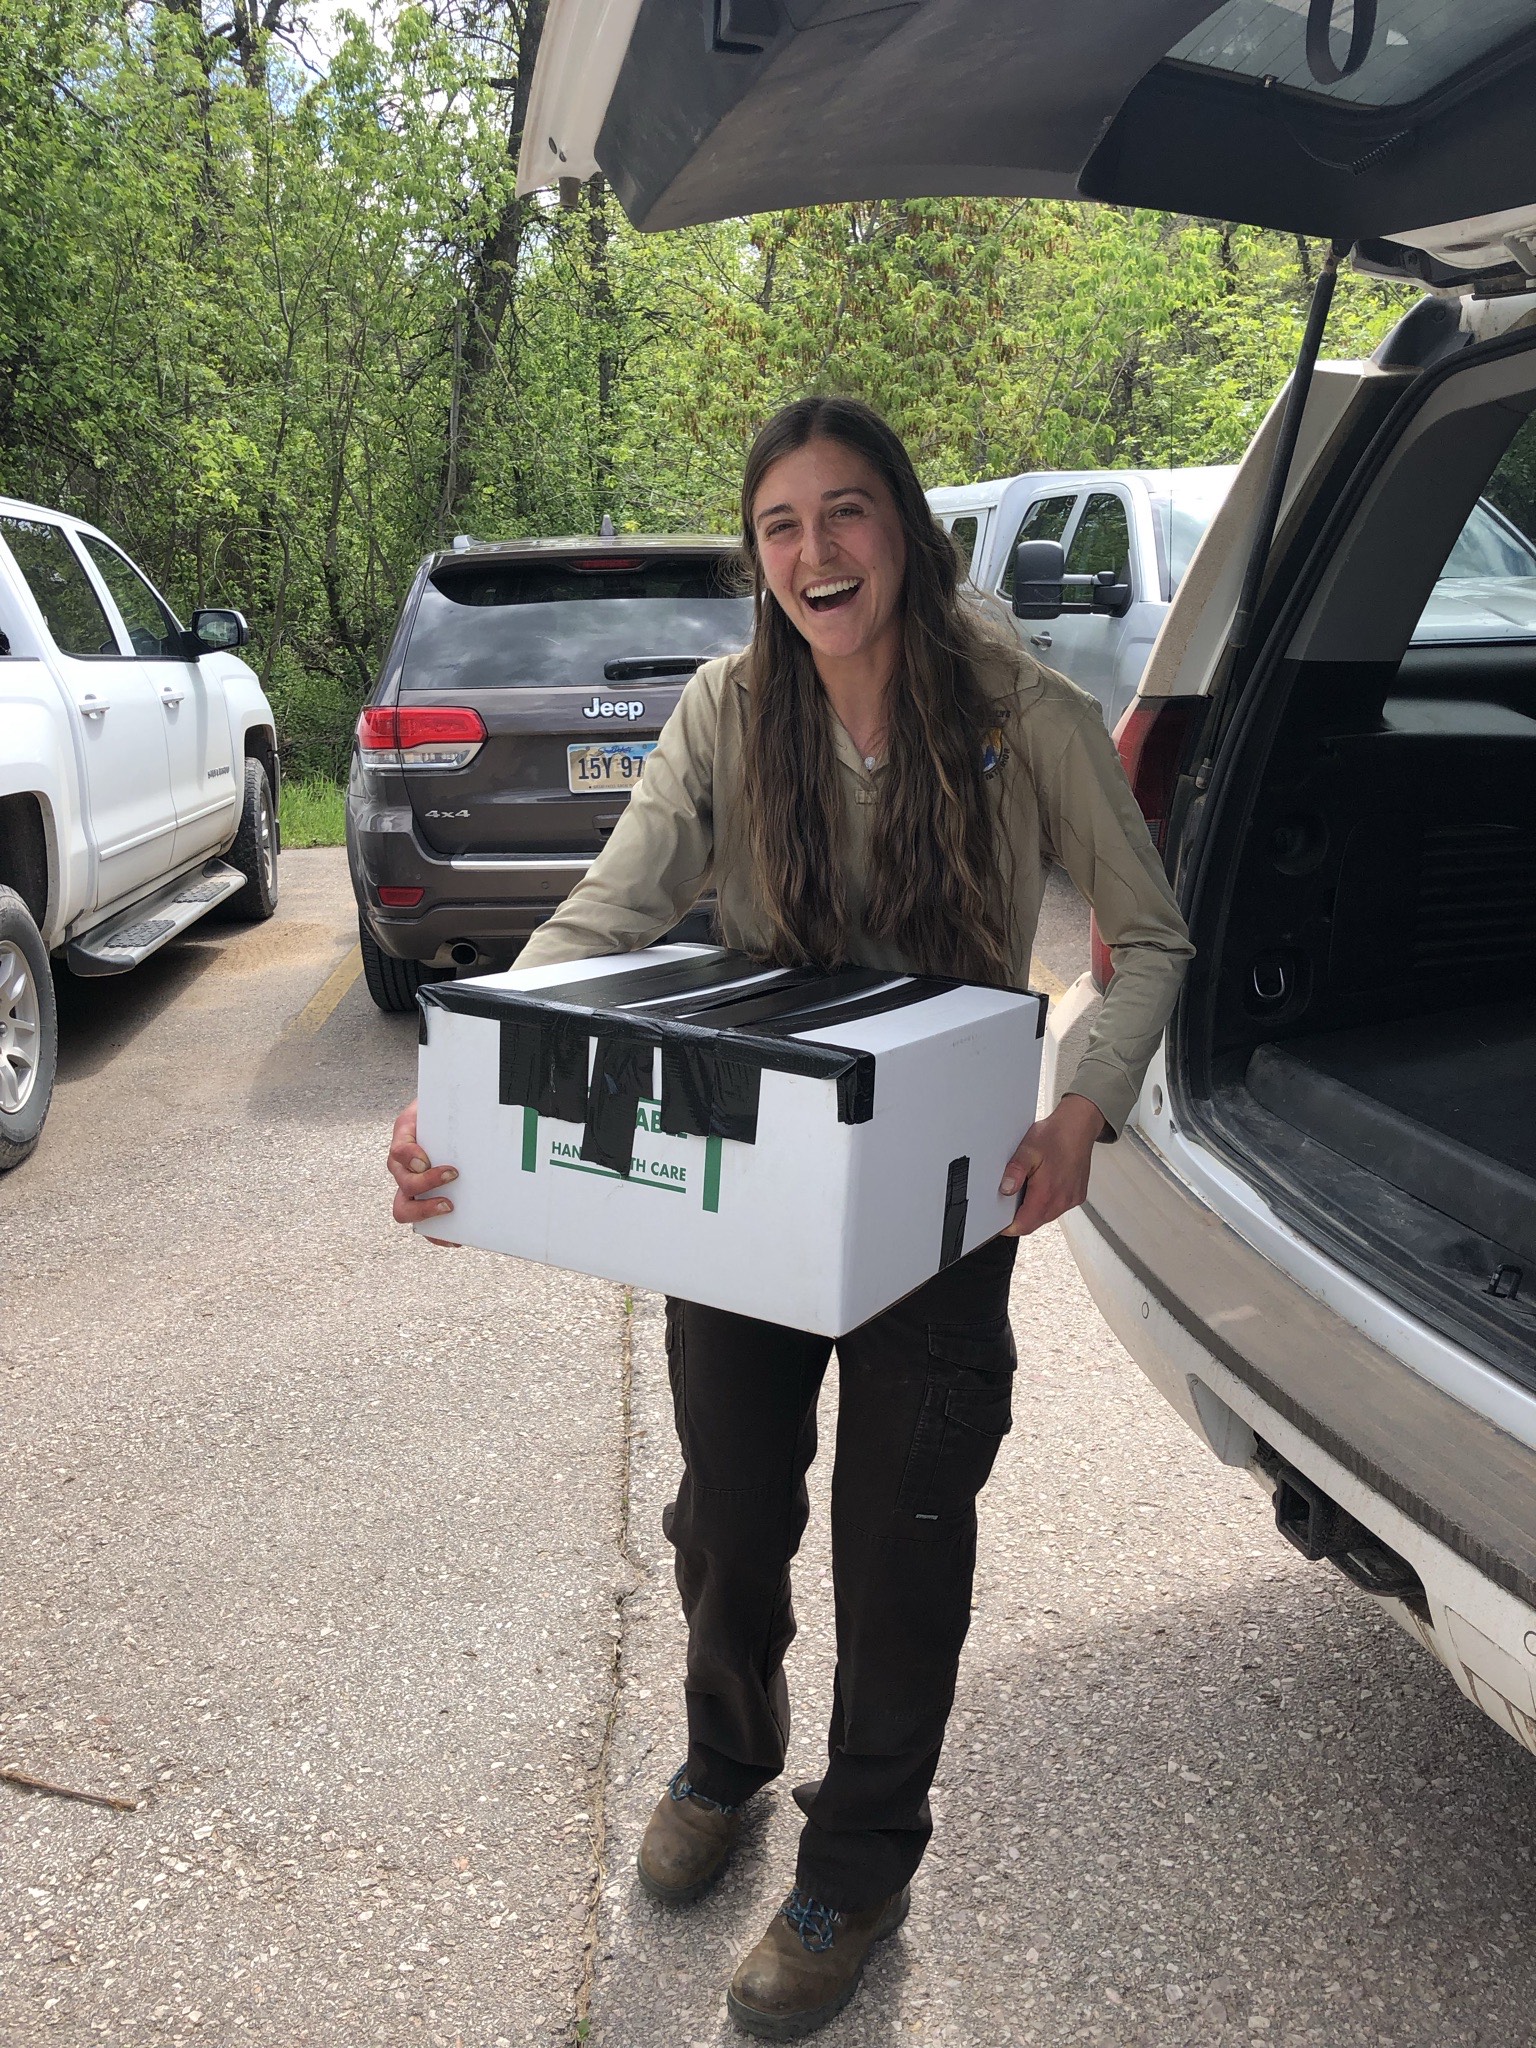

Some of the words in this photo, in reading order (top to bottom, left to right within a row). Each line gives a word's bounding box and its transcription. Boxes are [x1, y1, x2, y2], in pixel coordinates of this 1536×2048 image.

[583, 697, 644, 721] Jeep
[578, 756, 612, 780] 15Y
[424, 809, 471, 818] 4x4
[650, 1161, 687, 1181] CARE
